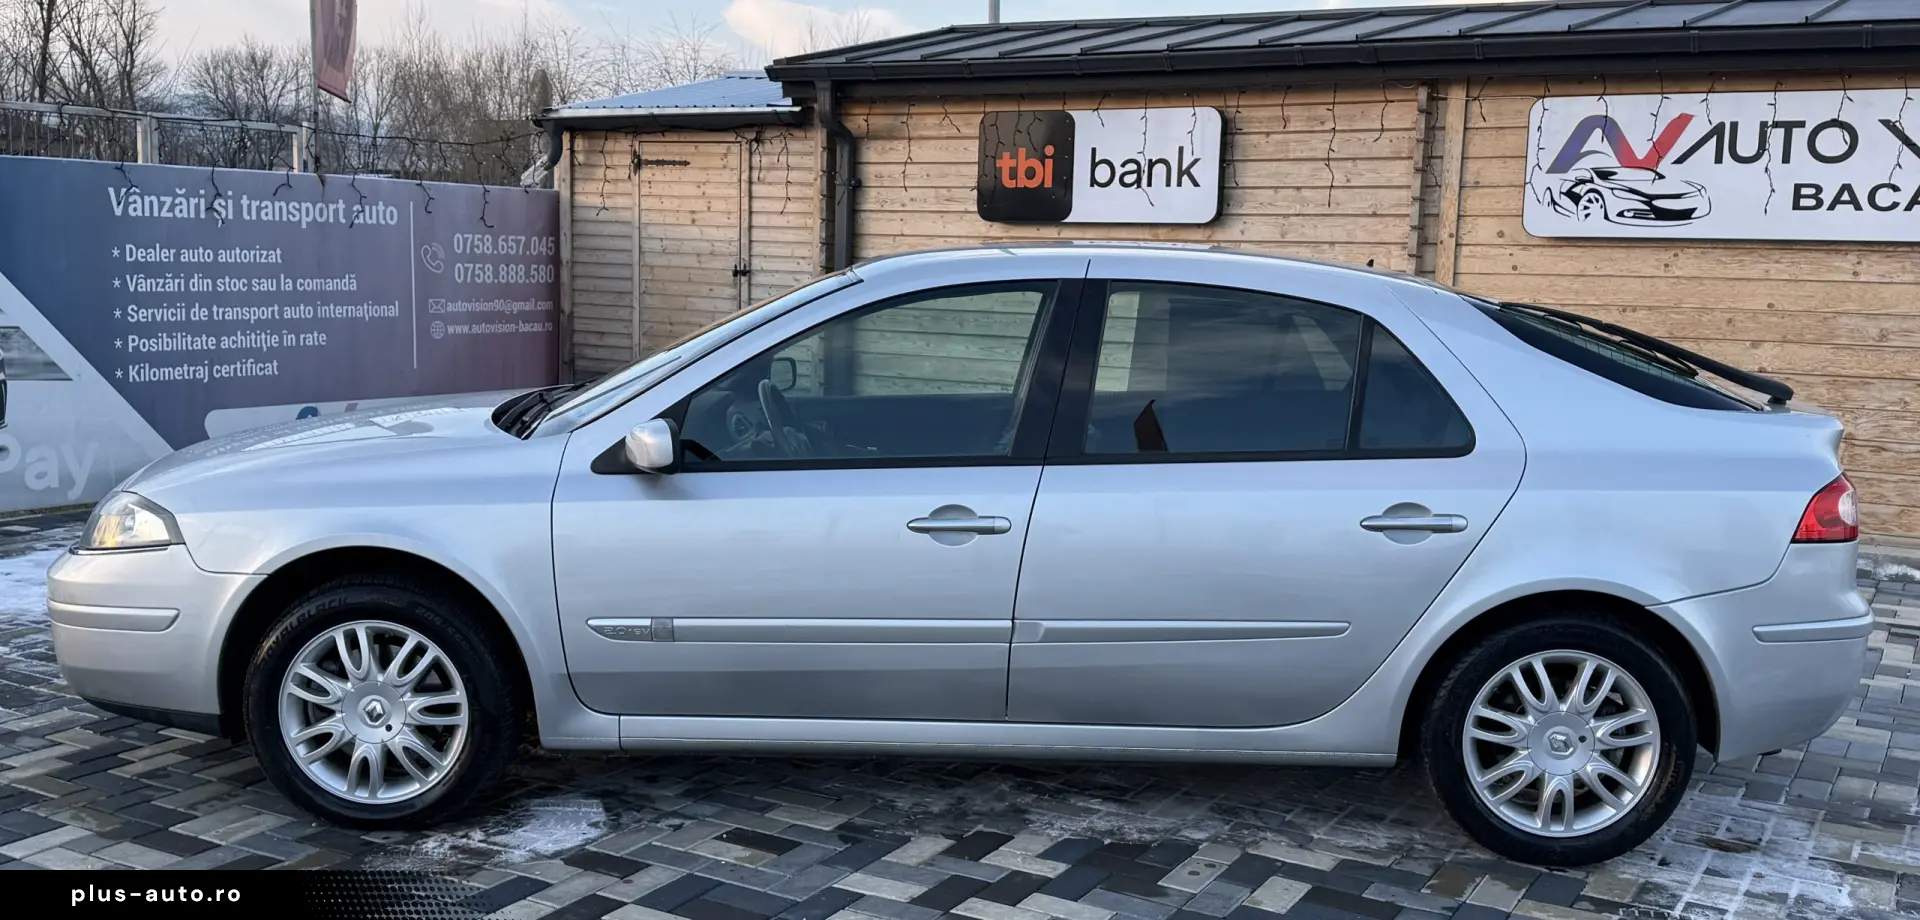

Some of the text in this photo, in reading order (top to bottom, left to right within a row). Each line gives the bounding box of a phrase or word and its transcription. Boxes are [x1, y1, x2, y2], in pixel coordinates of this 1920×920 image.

[1671, 119, 1859, 164] AUTO
[996, 145, 1202, 188] tbi bank
[107, 186, 206, 219] Vânzări
[240, 195, 346, 229] transport
[352, 201, 398, 225] auto
[125, 243, 282, 263] Dealer auto autorizat
[453, 233, 556, 256] 0758.657.045
[125, 273, 357, 292] Vânzări din stoc sau la comandă
[454, 263, 555, 283] 0758.888.580
[127, 302, 186, 322] Servicii
[190, 302, 209, 321] de
[212, 303, 280, 324] transport
[283, 306, 314, 319] auto
[446, 298, 554, 314] autovision90@gmail.com
[447, 320, 553, 335] www.autovision-bacau.ro
[128, 332, 217, 352] Posibilitate
[282, 330, 296, 347] în
[299, 330, 327, 347] rate
[128, 358, 279, 383] Kilometraj certificat
